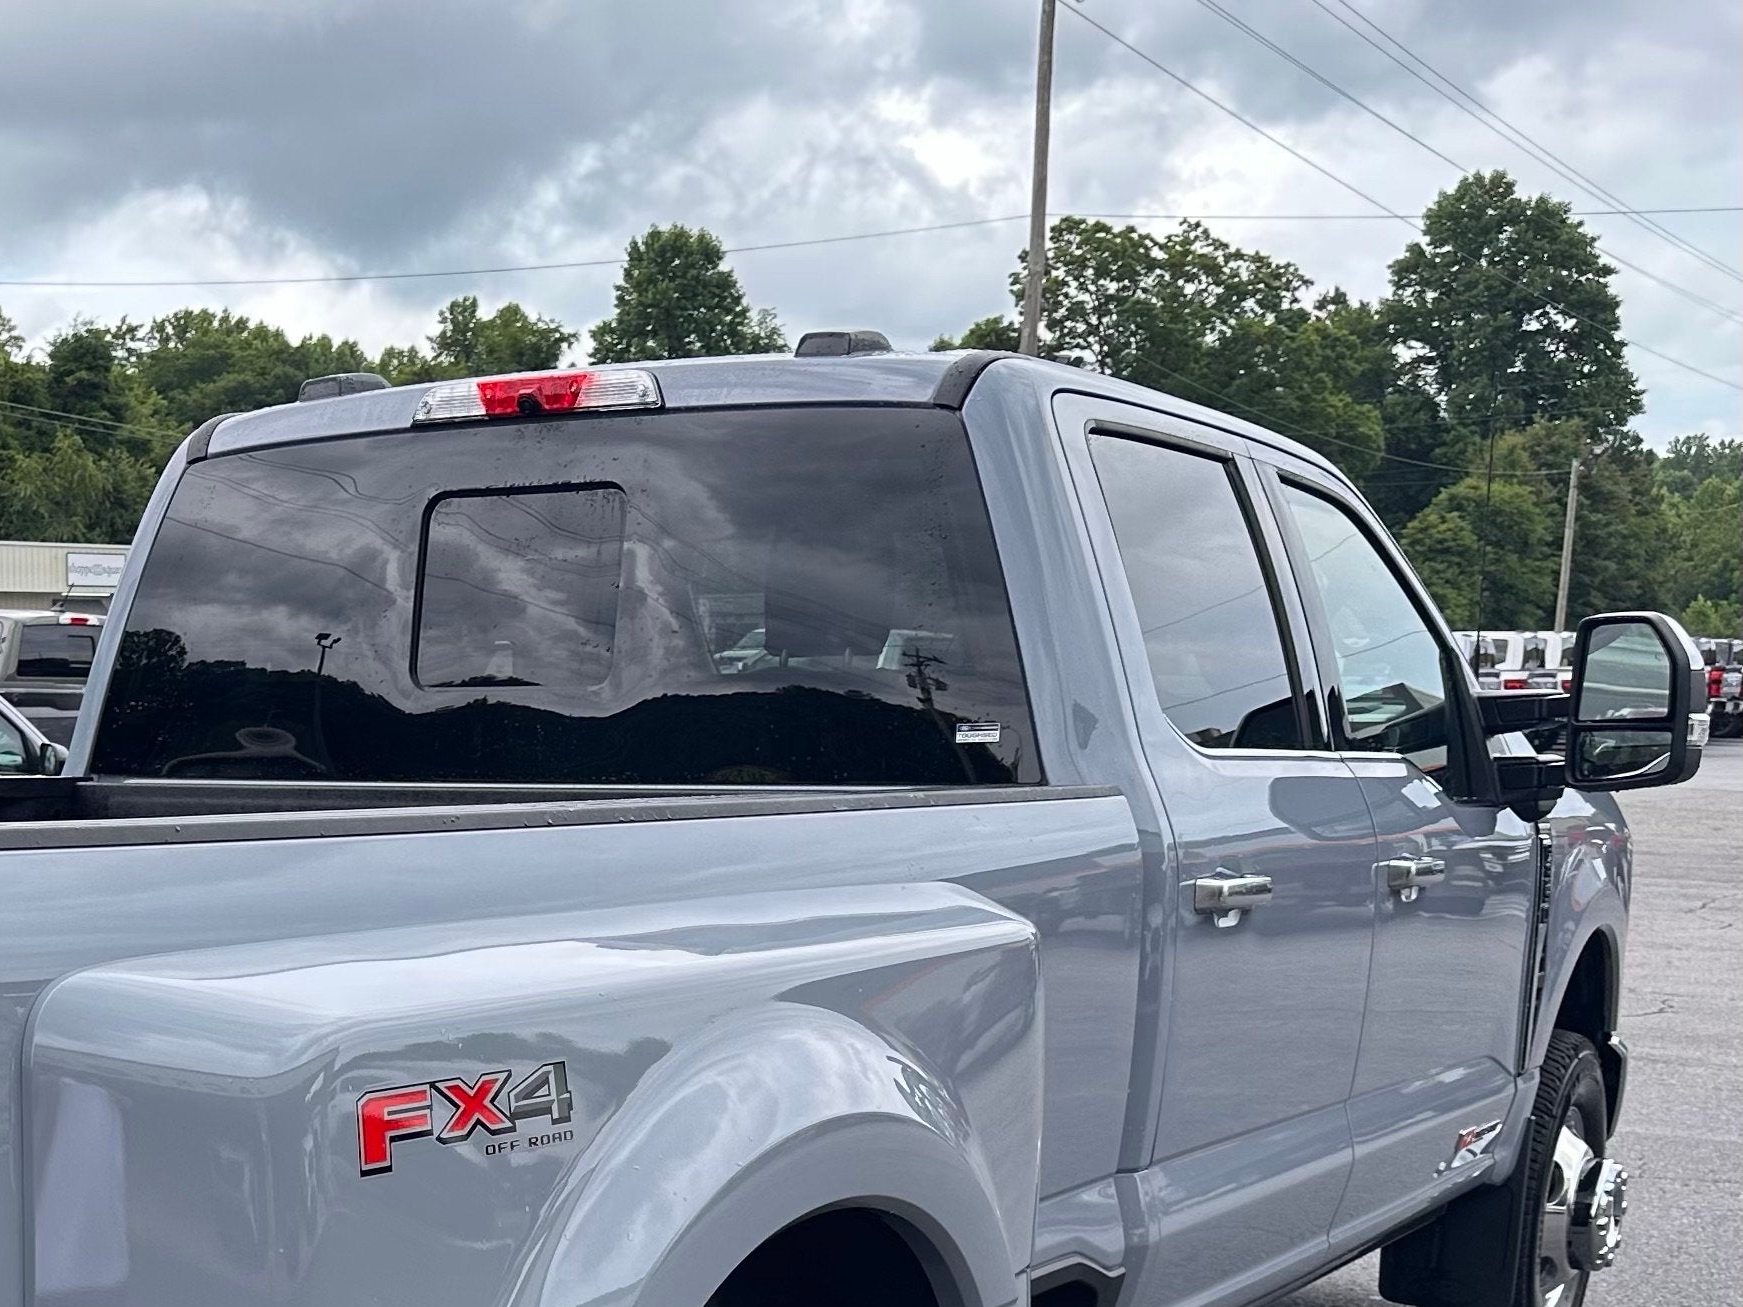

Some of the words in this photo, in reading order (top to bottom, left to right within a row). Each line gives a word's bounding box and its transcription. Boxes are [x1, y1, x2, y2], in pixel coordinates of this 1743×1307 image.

[355, 1060, 574, 1178] FX4
[484, 1140, 521, 1156] OFF
[528, 1129, 575, 1149] ROAD
